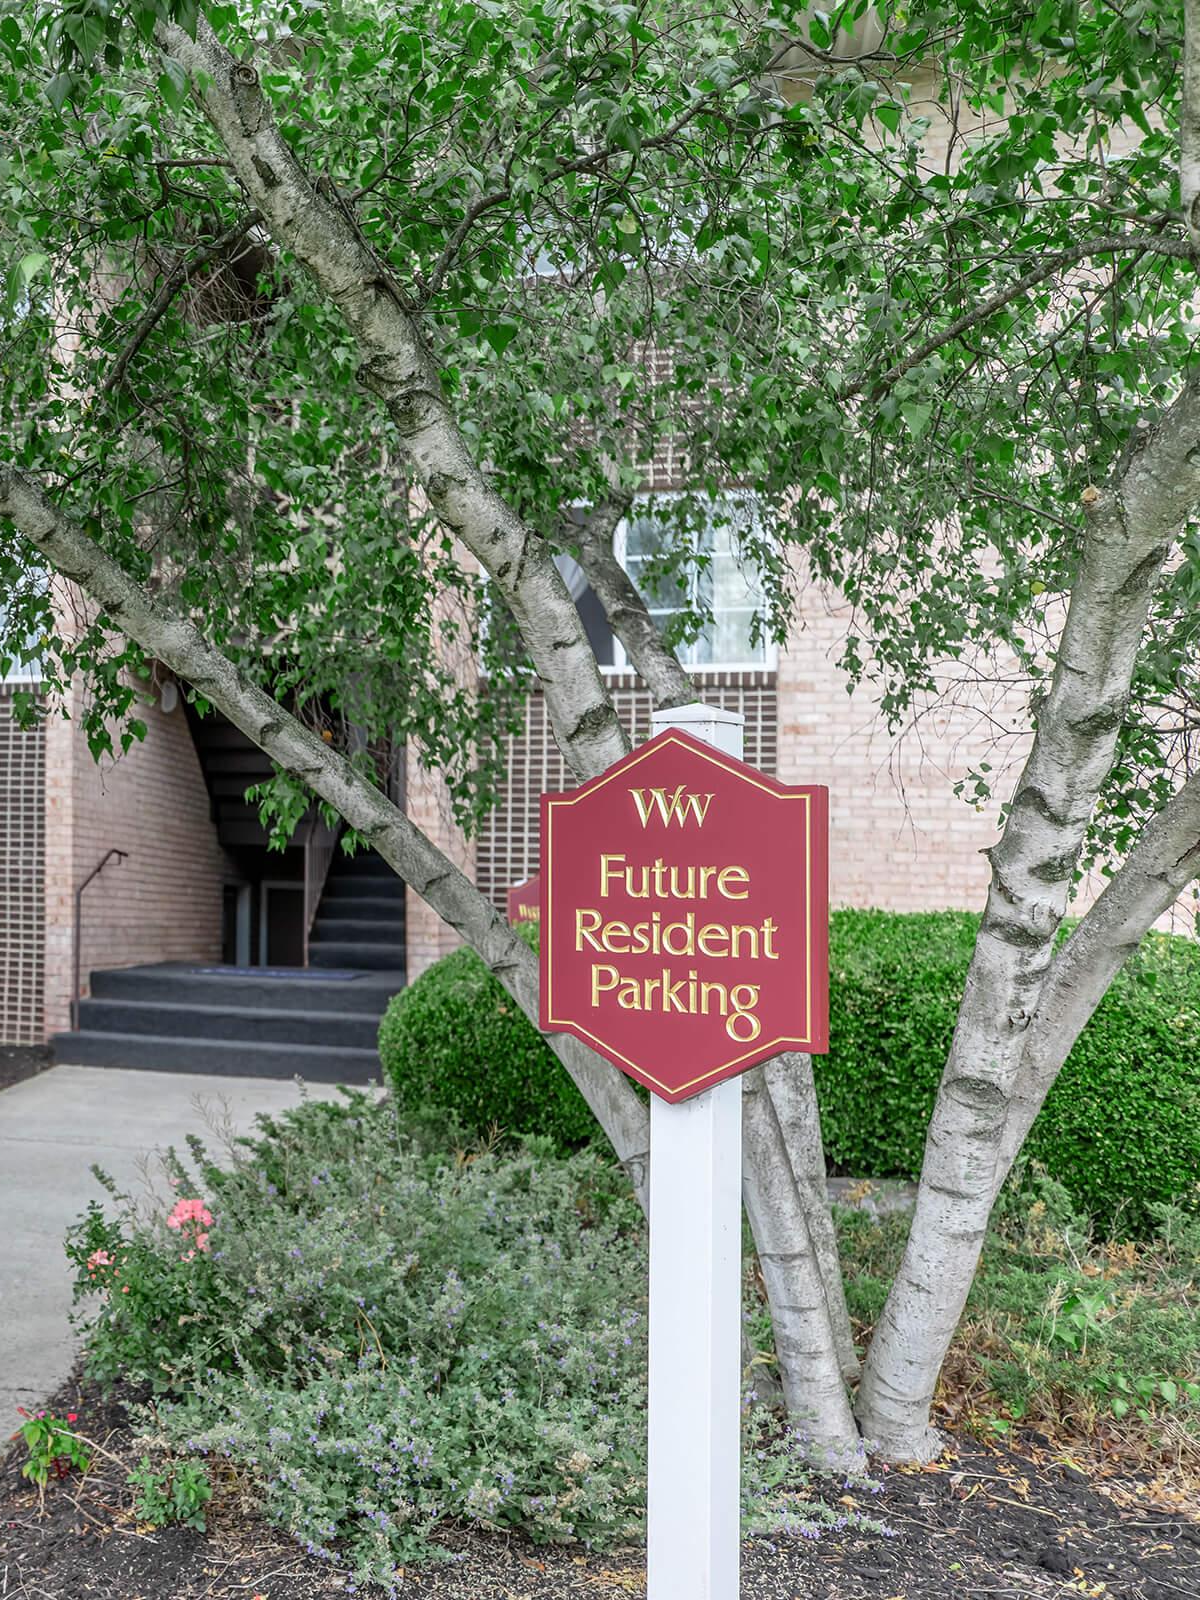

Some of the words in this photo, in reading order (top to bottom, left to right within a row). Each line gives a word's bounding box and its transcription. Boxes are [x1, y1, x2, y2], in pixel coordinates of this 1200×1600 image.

[600, 853, 750, 899] Future
[575, 908, 780, 960] Resident
[591, 963, 762, 1043] Parking
